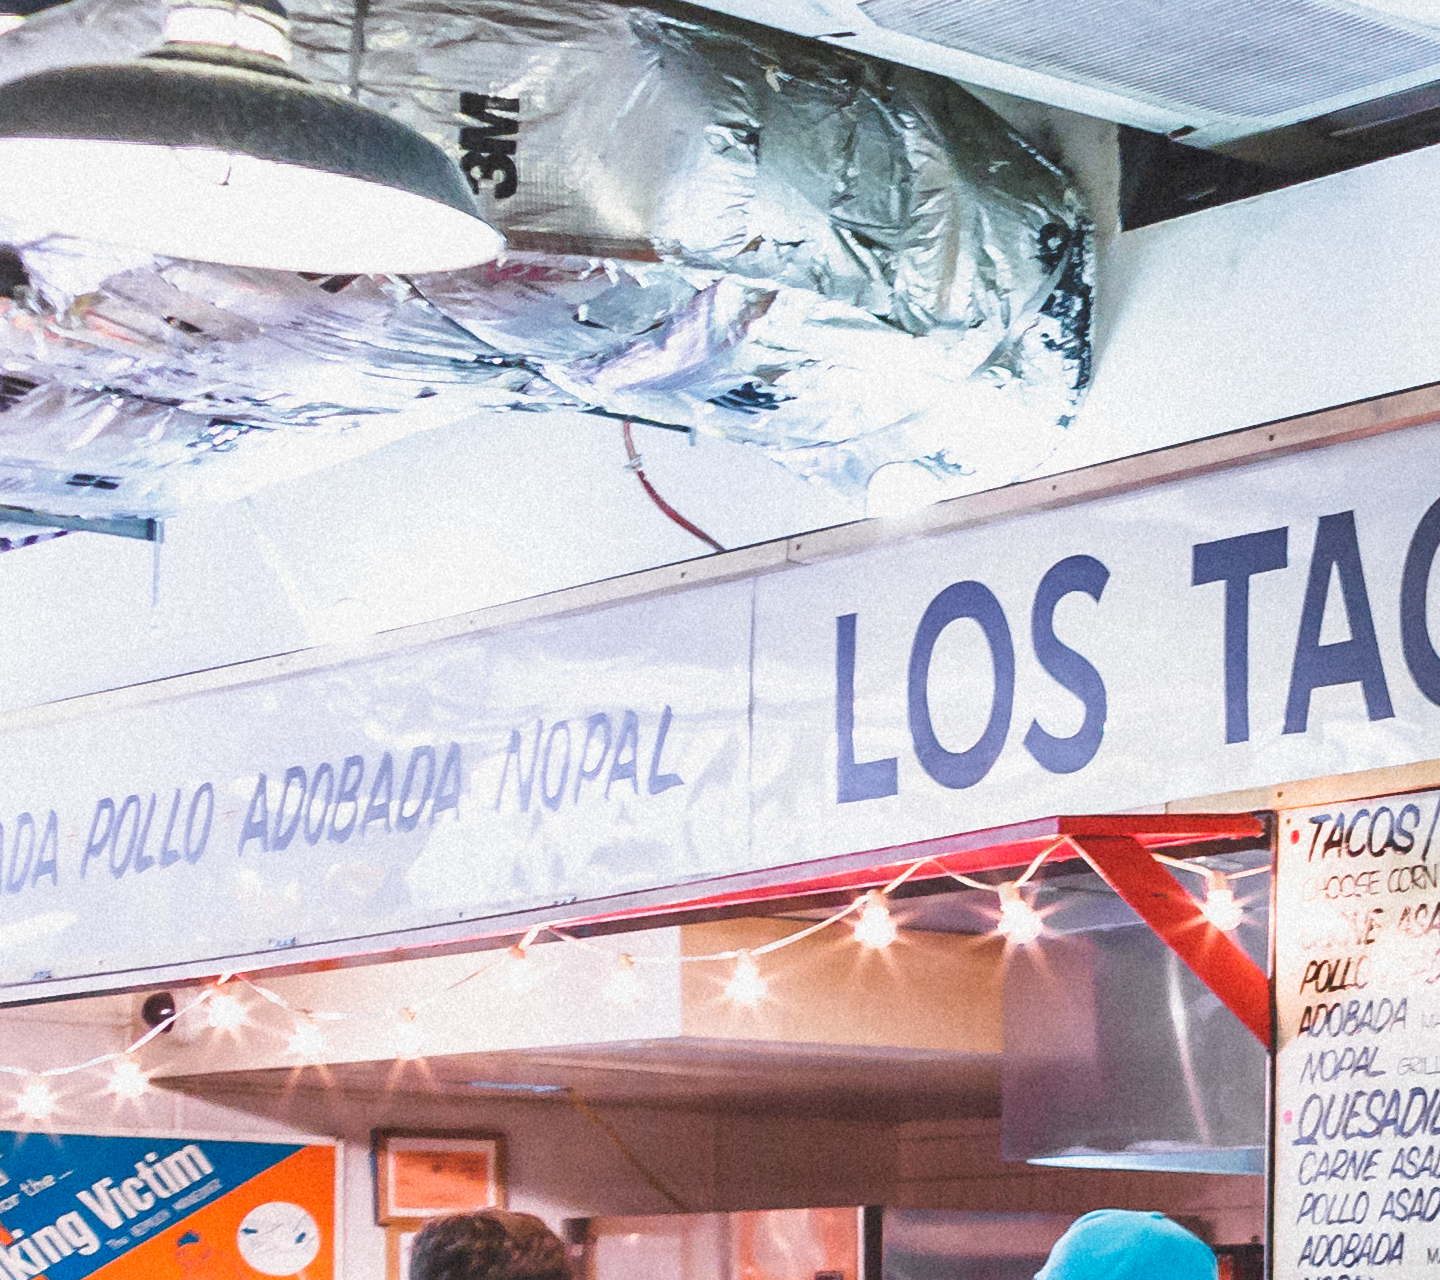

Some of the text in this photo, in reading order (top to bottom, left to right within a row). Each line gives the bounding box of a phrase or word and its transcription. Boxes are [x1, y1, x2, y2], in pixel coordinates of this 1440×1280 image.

[458, 90, 522, 201] 3M
[834, 553, 1112, 804] LOS
[80, 704, 685, 880] POLLO ADOBADA NOPAL
[1387, 863, 1438, 894] CORN
[1297, 996, 1409, 1039] ADOBADA
[1299, 1045, 1388, 1086] NOPAL
[75, 1143, 215, 1230] Victim
[1299, 1148, 1383, 1187] CARNE
[1296, 1190, 1371, 1226] POLLO
[1297, 1231, 1405, 1269] ADOBADA
